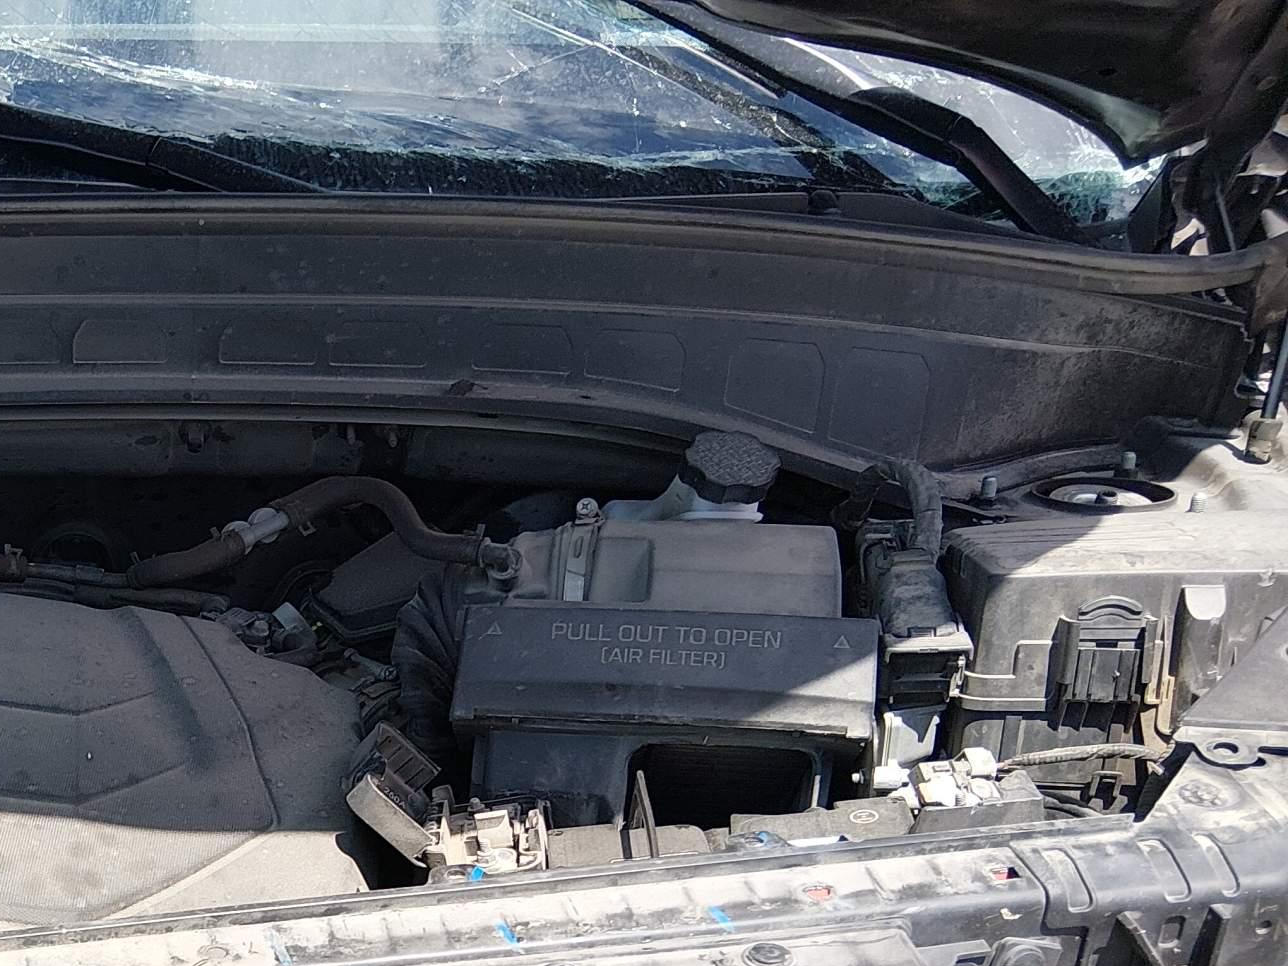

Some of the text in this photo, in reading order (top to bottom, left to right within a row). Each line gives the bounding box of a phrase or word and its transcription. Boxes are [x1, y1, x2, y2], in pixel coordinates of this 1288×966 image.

[551, 622, 782, 649] PULL OUT TO OPEN
